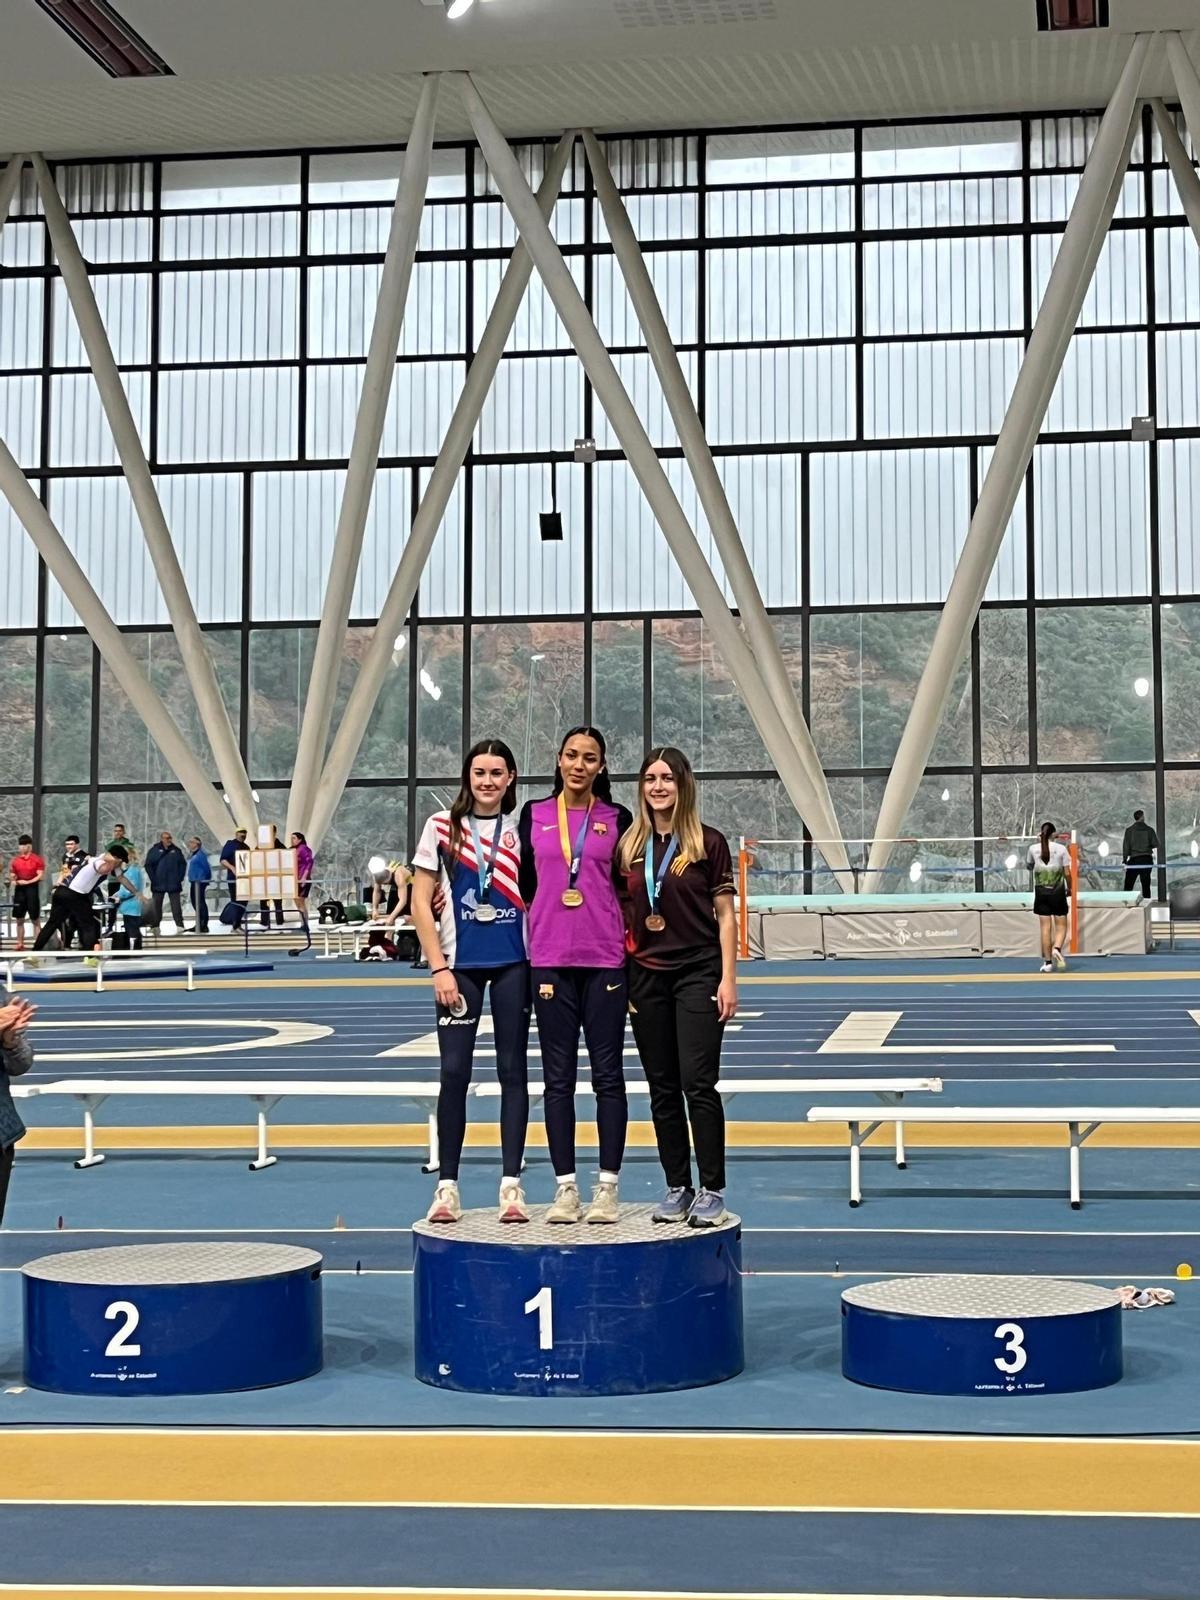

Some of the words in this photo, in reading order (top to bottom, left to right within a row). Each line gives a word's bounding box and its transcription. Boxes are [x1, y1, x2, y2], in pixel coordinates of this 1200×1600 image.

[104, 1300, 141, 1357] 2
[525, 1287, 553, 1350] 1
[994, 1322, 1027, 1374] 3
